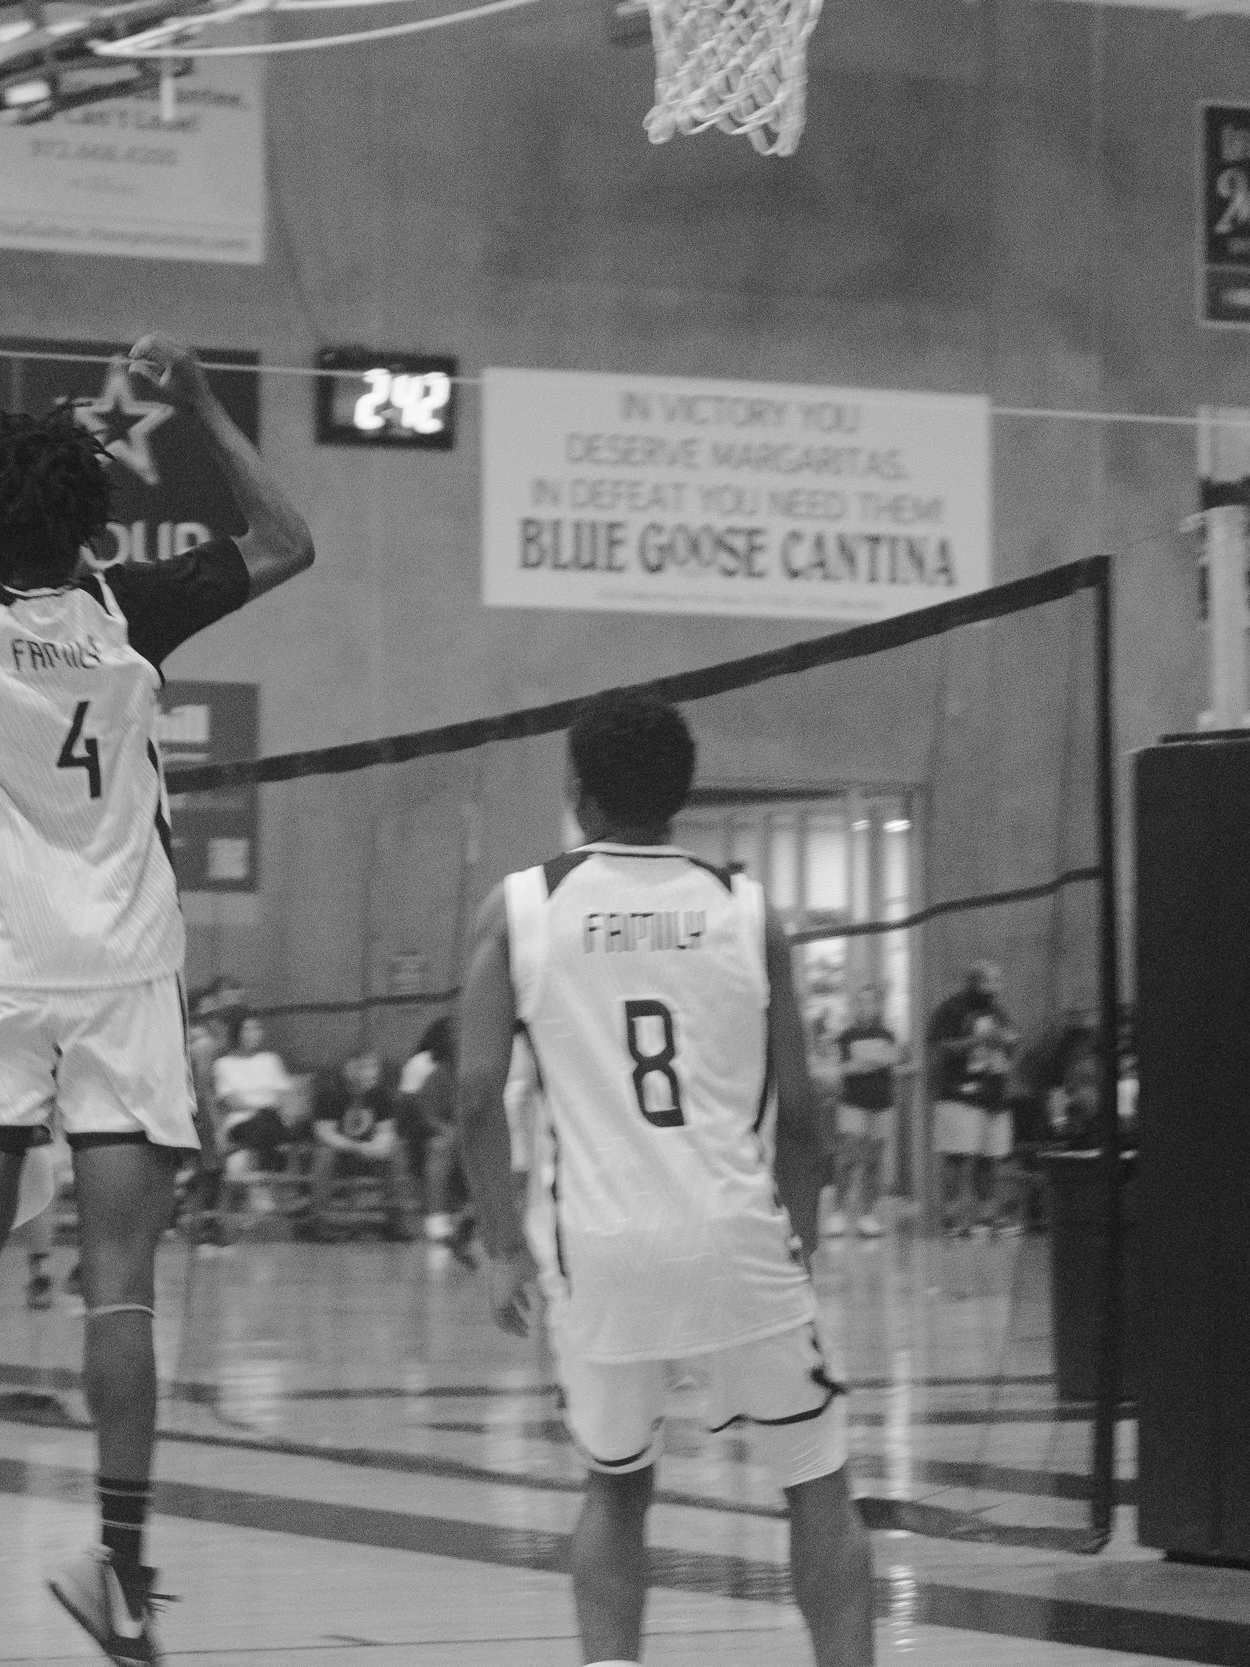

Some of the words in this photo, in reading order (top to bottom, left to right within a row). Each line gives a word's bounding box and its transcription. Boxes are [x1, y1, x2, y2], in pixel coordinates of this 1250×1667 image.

[619, 392, 651, 422] IN
[663, 394, 787, 429] VICTORY
[798, 401, 860, 434] YOU
[565, 432, 701, 469] DESERVE
[531, 477, 561, 508] IN
[571, 479, 688, 513] DEFEAT
[698, 484, 761, 517] YOU
[769, 488, 846, 521] NEED
[518, 517, 627, 572] BLUE
[639, 522, 767, 579] GOOSE
[781, 529, 958, 587] CANTINA
[57, 700, 102, 799] 4
[582, 910, 707, 953] FAMILY
[624, 1000, 685, 1128] 8
